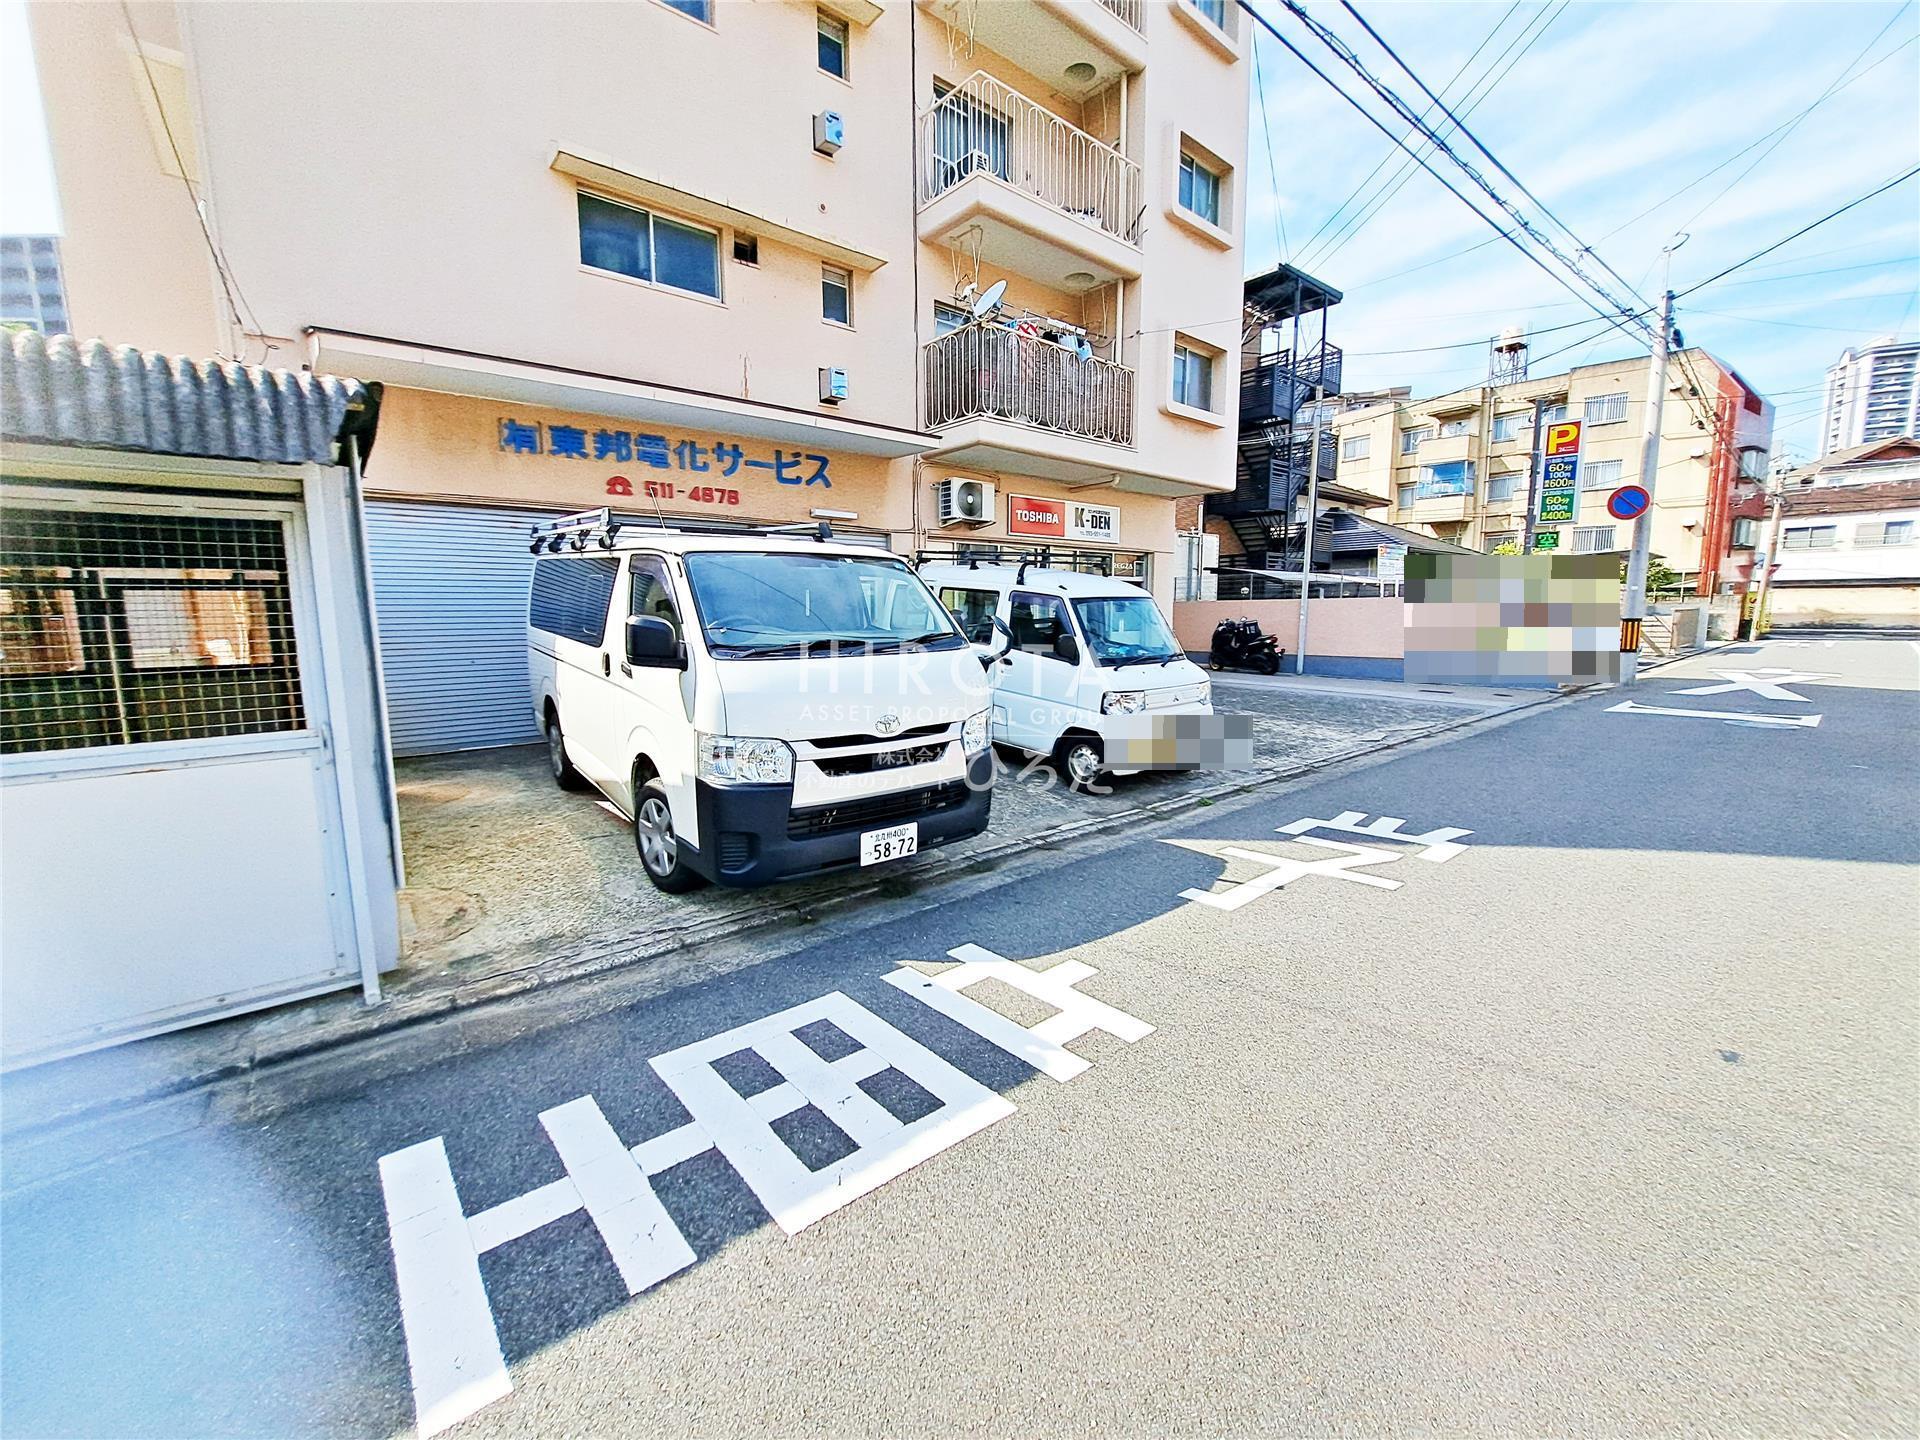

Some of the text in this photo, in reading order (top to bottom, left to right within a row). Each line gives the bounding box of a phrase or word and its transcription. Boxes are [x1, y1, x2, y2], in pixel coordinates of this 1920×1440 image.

[1548, 424, 1578, 454] P
[1549, 463, 1573, 472] 60分
[644, 480, 741, 506] 511-4878
[1546, 496, 1569, 505] 60分
[1016, 509, 1059, 524] TOSHIBA
[1075, 507, 1111, 530] K-DEN
[874, 837, 914, 860] 58-72
